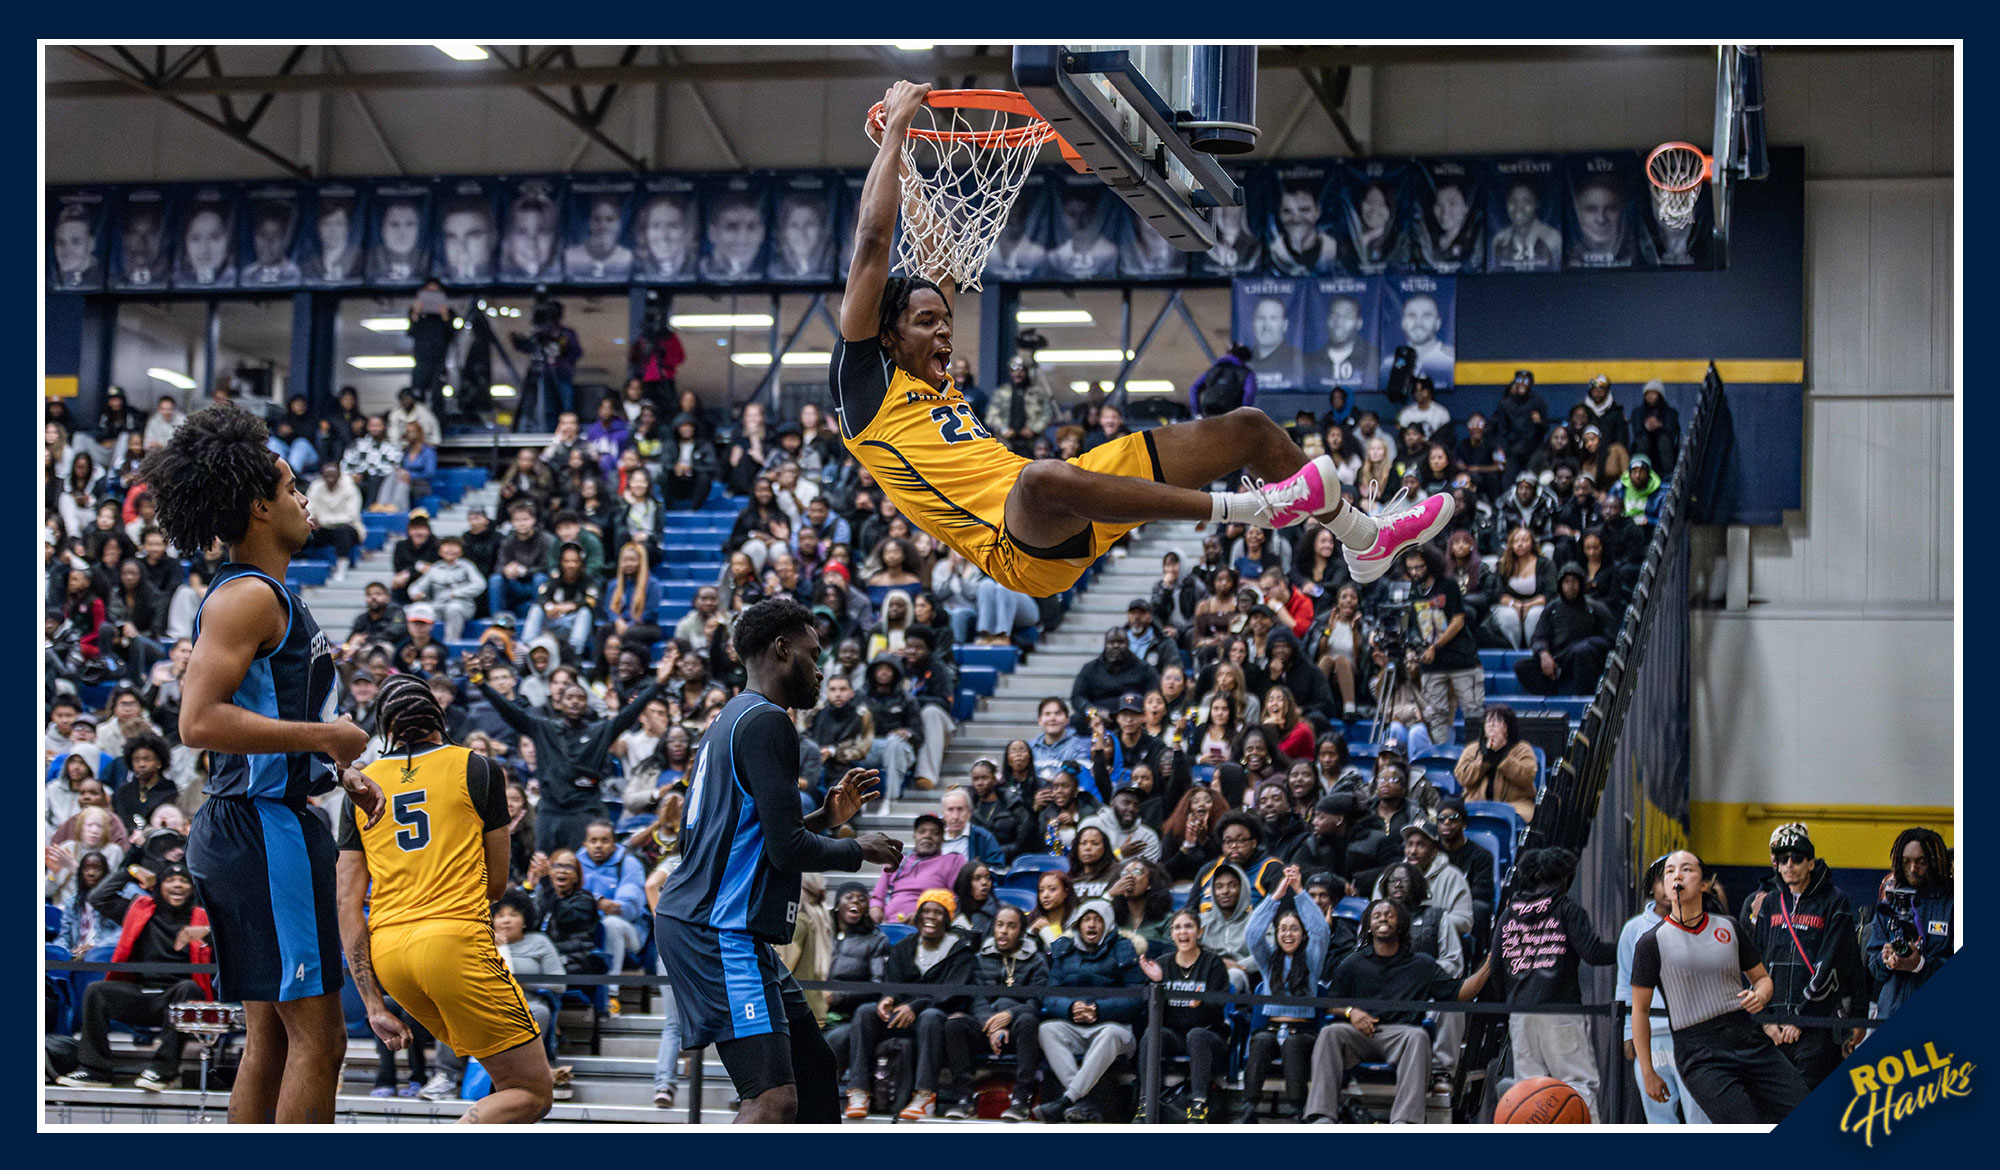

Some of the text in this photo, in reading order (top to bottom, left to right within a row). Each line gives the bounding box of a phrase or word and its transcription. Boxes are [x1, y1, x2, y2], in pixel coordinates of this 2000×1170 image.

[1333, 360, 1353, 380] 10
[930, 402, 992, 446] 23
[391, 788, 431, 853] 5
[295, 962, 305, 982] 4
[744, 1002, 756, 1020] 8
